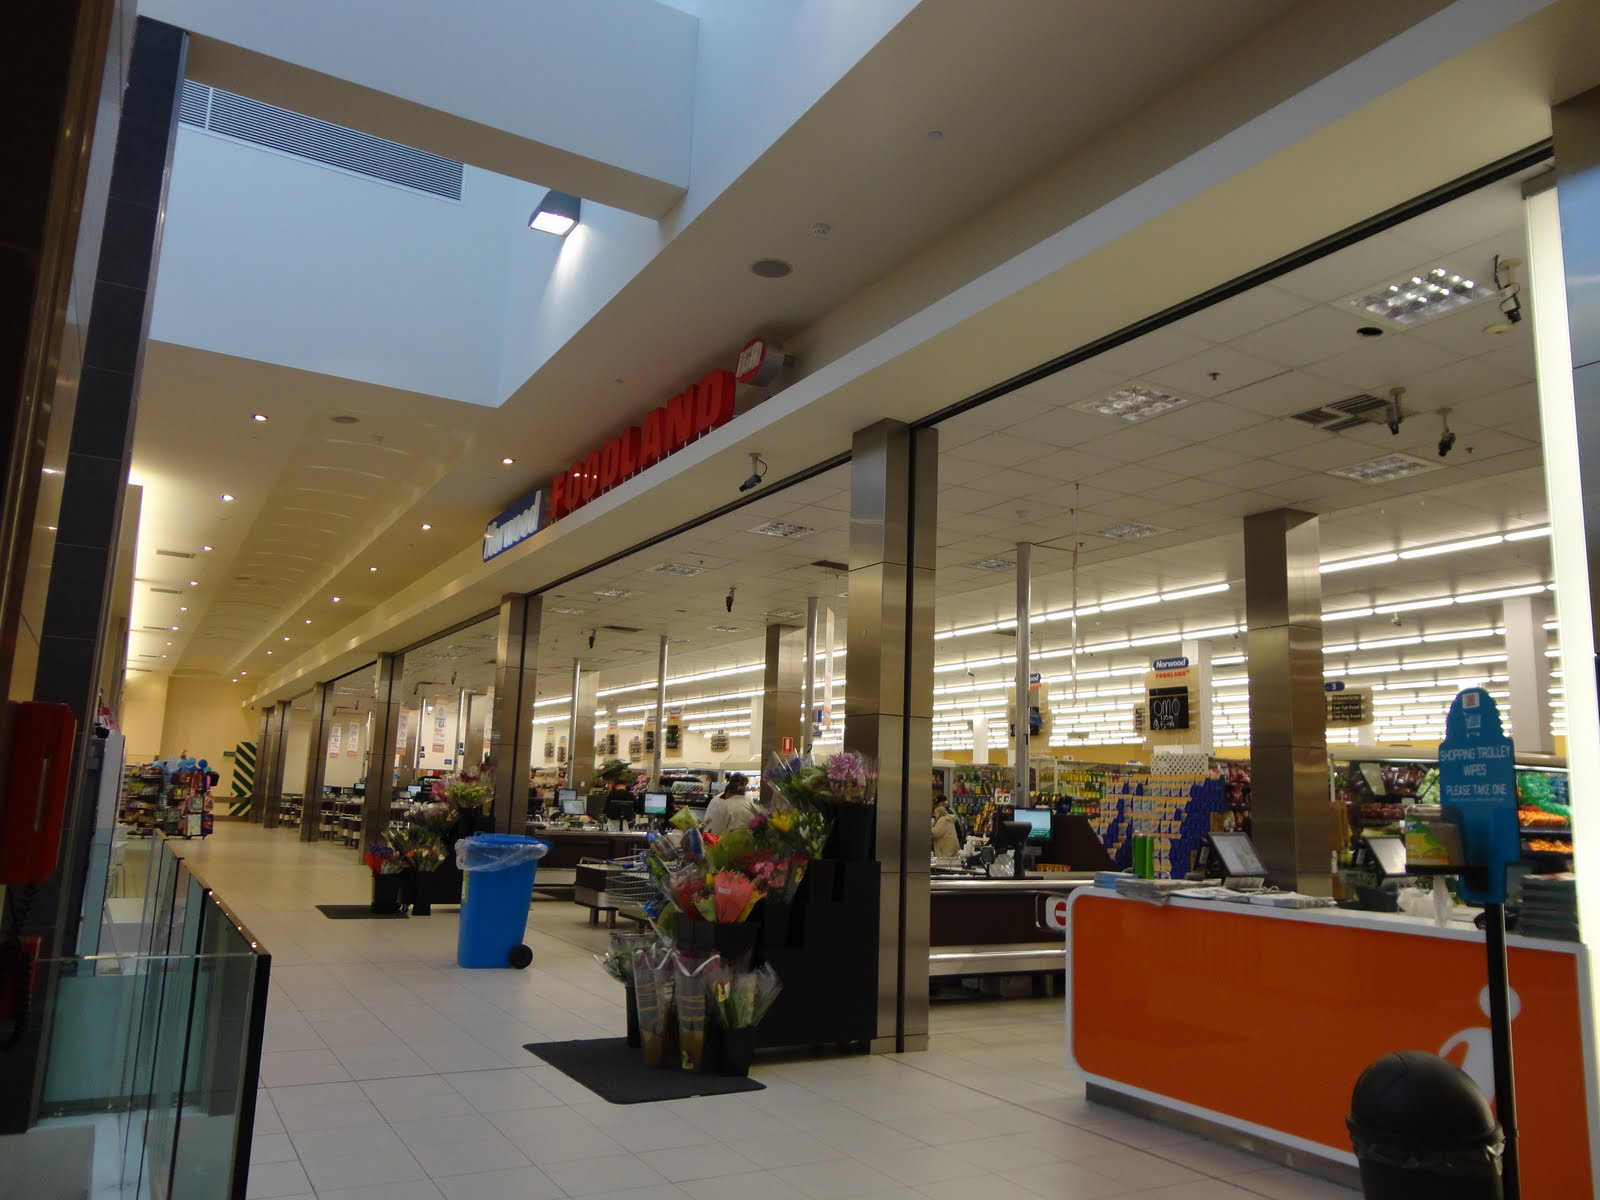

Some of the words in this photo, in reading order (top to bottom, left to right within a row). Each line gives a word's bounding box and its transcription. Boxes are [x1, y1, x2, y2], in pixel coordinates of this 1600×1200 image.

[550, 368, 735, 518] FOODLAND
[483, 490, 542, 559] Norwood
[1156, 658, 1186, 669] Norwood
[1440, 747, 1476, 762] SHOPPING
[1477, 745, 1511, 759] TROLLEY
[1463, 763, 1487, 776] WIPES
[1446, 784, 1471, 796] PLEASE
[1473, 783, 1490, 795] TAKE
[1491, 782, 1508, 795] ONE
